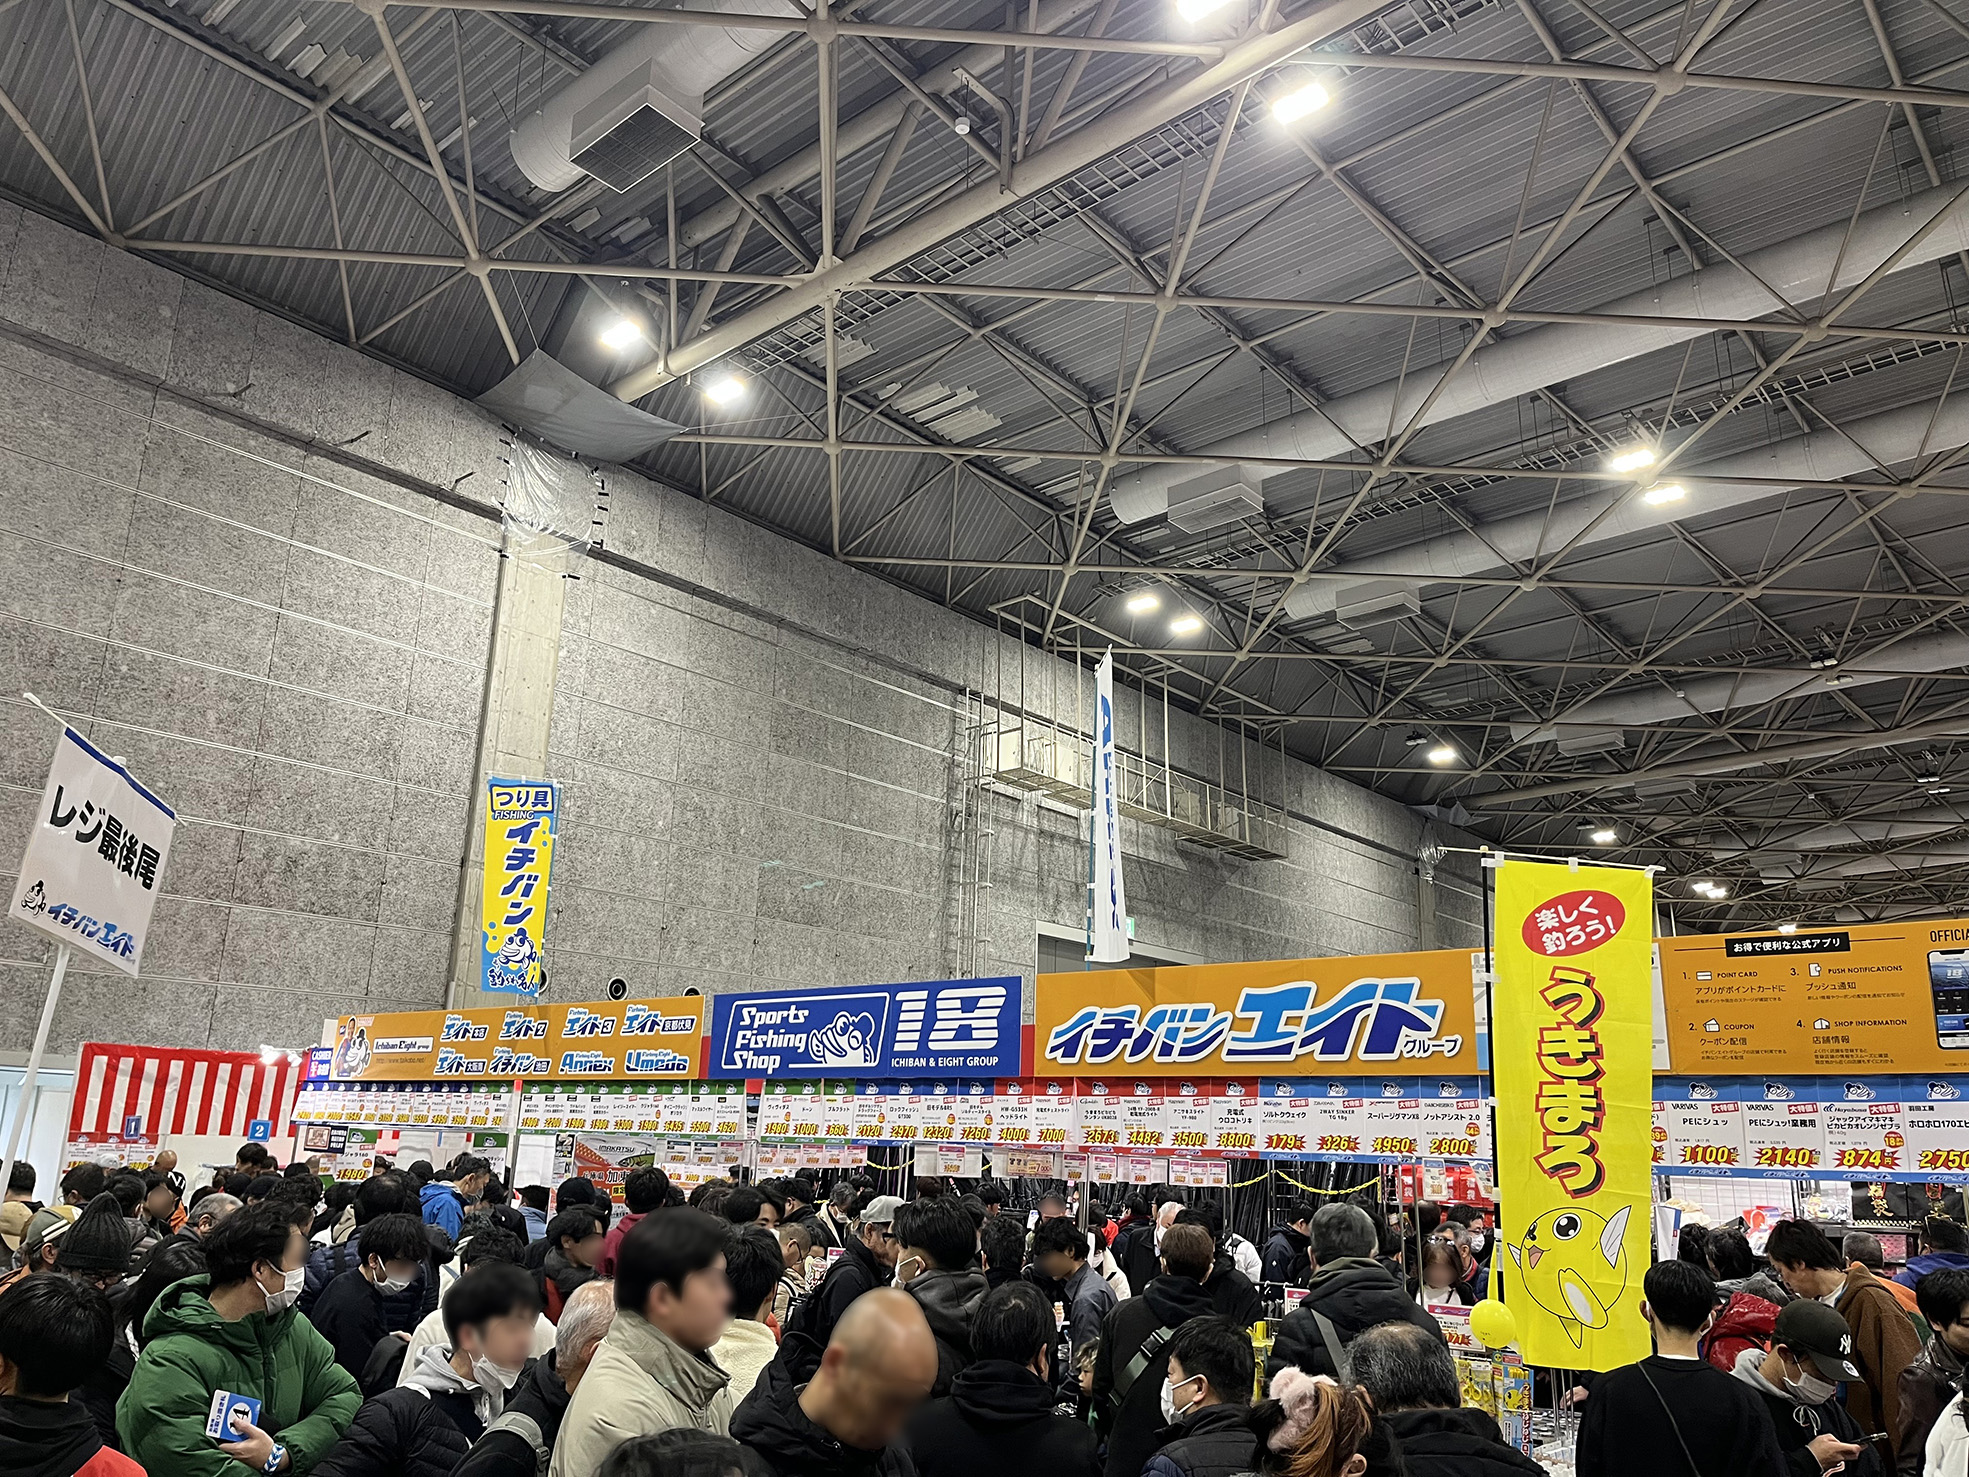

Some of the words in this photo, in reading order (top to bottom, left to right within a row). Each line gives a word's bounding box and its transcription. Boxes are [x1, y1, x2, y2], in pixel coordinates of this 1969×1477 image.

[496, 790, 549, 808] つり具
[494, 810, 534, 820] FISHING
[50, 785, 160, 890] レジ最後尾
[500, 820, 541, 926] イチバン
[1534, 895, 1599, 931] 楽しく
[1541, 915, 1616, 955] 釣ろう!
[1733, 937, 1840, 952] お得で便利な公式アプリ
[1847, 965, 1903, 973] NOTIFICATIONS
[1695, 984, 1787, 995] アプリがポイントカードに
[1805, 981, 1857, 991] プッシュ通知
[740, 1004, 809, 1029] Sports
[1048, 979, 1440, 1060] イチバンエイト
[1403, 1037, 1460, 1056] グループ
[536, 1023, 545, 1035] 2
[602, 1021, 612, 1033] 3
[664, 1019, 692, 1031] 京都伏見
[375, 1041, 398, 1050] Ichiban
[399, 1040, 417, 1051] Eight
[735, 1029, 807, 1053] Fishing
[1699, 1037, 1748, 1046] クーポン配信
[1812, 1035, 1850, 1044] 店舗情報
[560, 1053, 613, 1072] Annex
[626, 1052, 687, 1071] Umeda
[732, 1051, 780, 1075] Shop
[891, 1057, 926, 1067] ICHIBAN
[928, 1057, 936, 1067] &
[938, 1057, 964, 1067] EIGHT
[966, 1056, 999, 1066] GROUP
[1533, 965, 1606, 1200] うきまろ
[1712, 1102, 1738, 1112] 大特価!
[1789, 1104, 1817, 1113] 大特価!
[1870, 1105, 1898, 1113] 大特価!
[1423, 1113, 1466, 1121] ノットアシスト
[1682, 1118, 1728, 1126] PEにシュッ
[1748, 1119, 1817, 1128] PEにシュッ!業務用
[130, 1121, 136, 1135] 1
[254, 1124, 265, 1137] 2
[1271, 1135, 1295, 1148] 179
[1323, 1136, 1348, 1149] 326
[598, 1145, 635, 1153] IMAKATSU
[1684, 1146, 1729, 1164] 1,100
[1760, 1148, 1810, 1166] 2,140
[1843, 1150, 1881, 1166] 874
